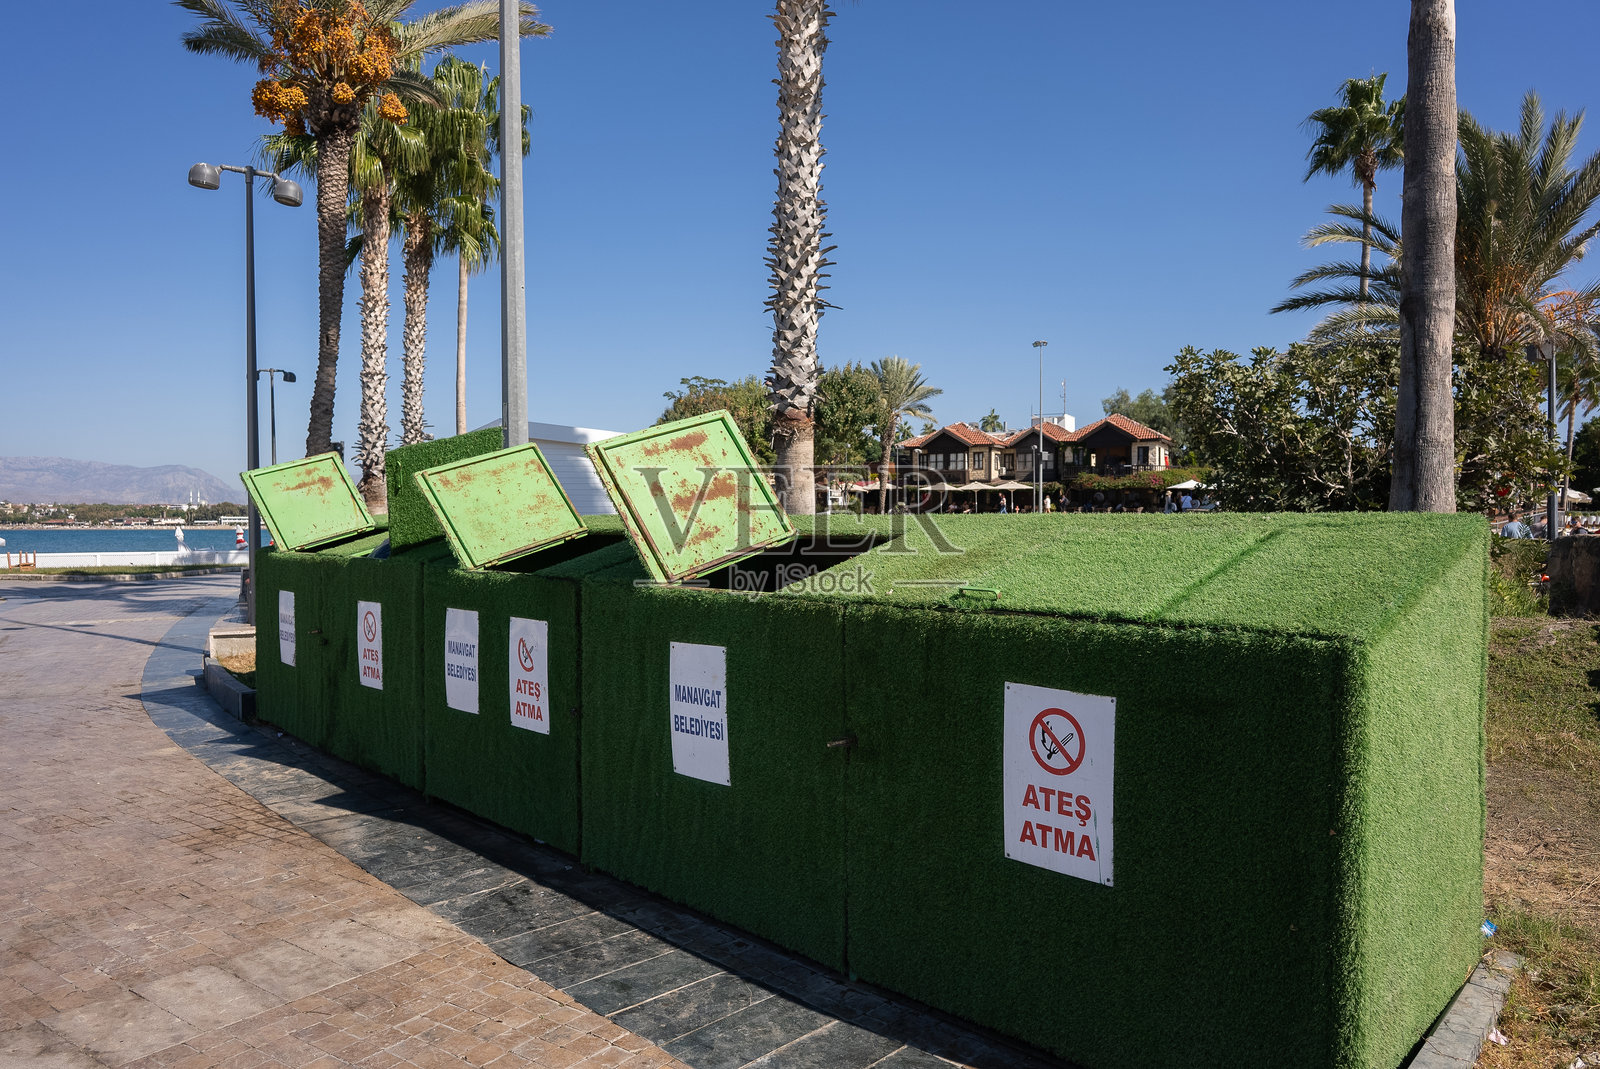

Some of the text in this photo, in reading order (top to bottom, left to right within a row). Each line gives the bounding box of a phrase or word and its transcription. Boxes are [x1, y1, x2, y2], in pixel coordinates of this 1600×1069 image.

[362, 647, 379, 665] ATEŞ
[447, 640, 476, 659] MANAVGAT
[362, 665, 381, 680] ATMA
[447, 662, 477, 682] BELEDİYESİ
[516, 678, 541, 701] ATEŞ
[674, 684, 722, 708] MANAVGAT
[515, 701, 543, 722] ATMA
[674, 714, 724, 741] BELEDİYESİ
[1022, 783, 1092, 827] ATEŞ
[1019, 820, 1096, 862] ATMA
